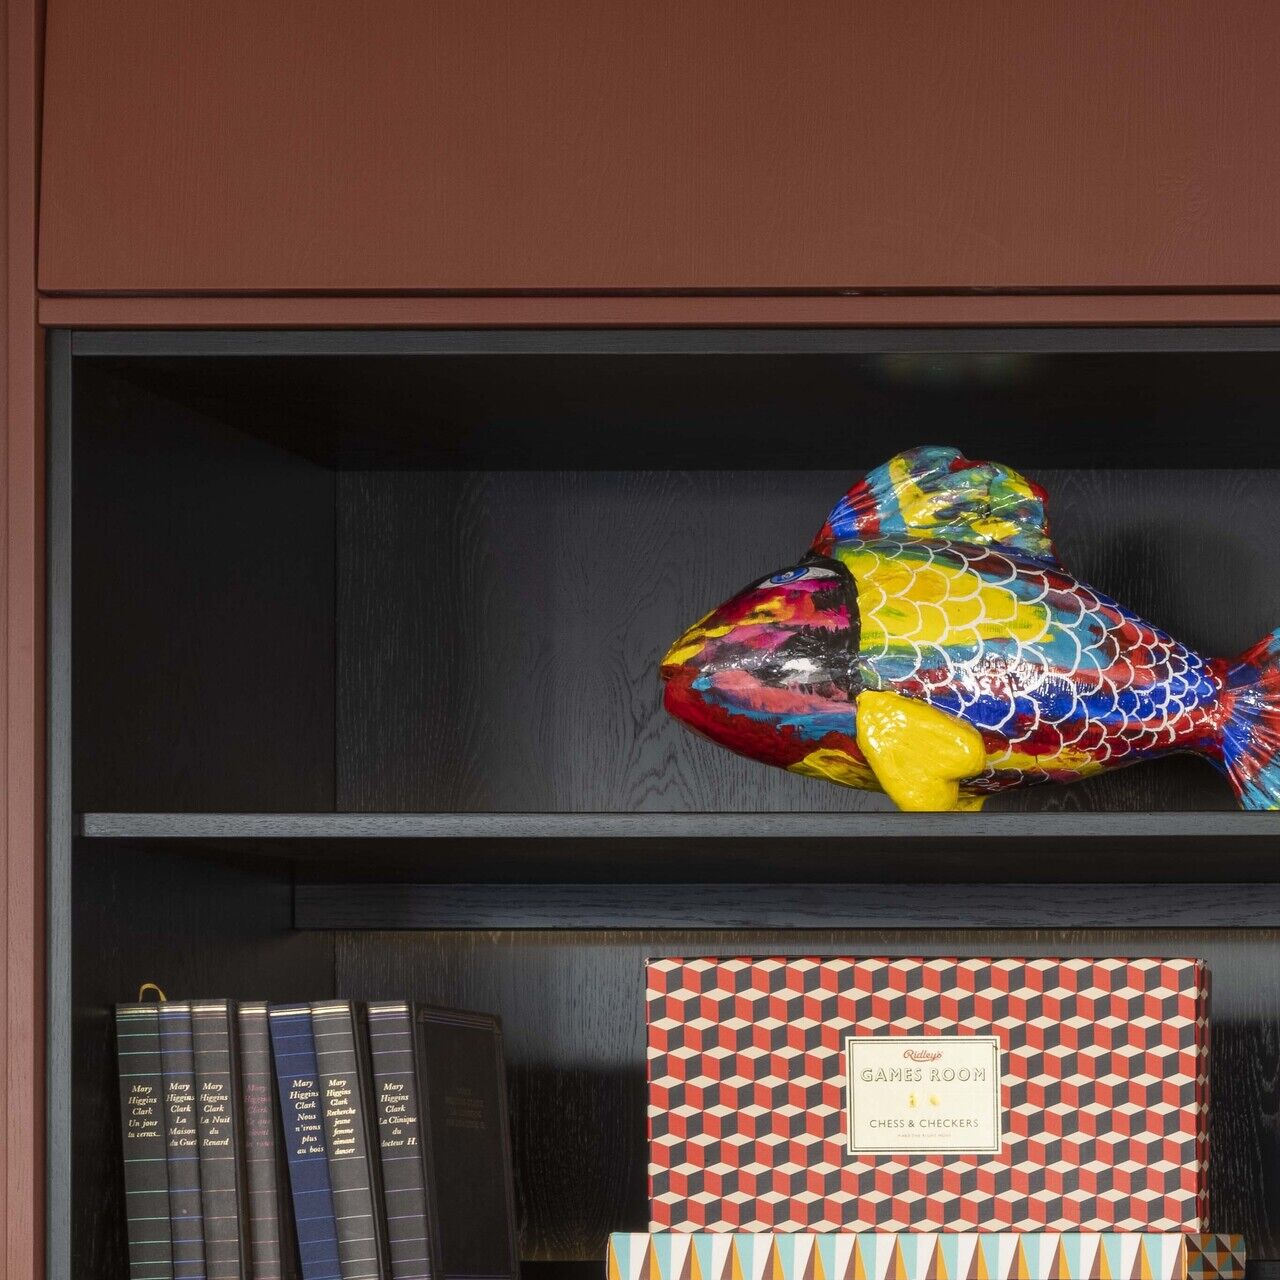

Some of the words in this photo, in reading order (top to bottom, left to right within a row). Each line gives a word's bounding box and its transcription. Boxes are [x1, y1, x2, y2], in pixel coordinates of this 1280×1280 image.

[860, 1067, 922, 1082] GAMES
[930, 1067, 986, 1082] ROOM
[169, 1083, 190, 1092] Mary
[202, 1083, 224, 1092] Mary
[292, 1080, 314, 1088] Mary
[328, 1080, 346, 1088] Mary
[383, 1083, 404, 1092] Mary
[132, 1084, 152, 1094] Mary
[326, 1089, 352, 1097] Higgins
[166, 1094, 196, 1102] Higgins
[200, 1094, 228, 1102] Higgins
[290, 1090, 319, 1100] Higgins
[380, 1094, 409, 1103] Higgins
[128, 1096, 157, 1106] Higgins
[294, 1100, 316, 1110] Clark
[132, 1107, 153, 1115] Clark
[170, 1104, 192, 1112] Clark
[204, 1104, 224, 1112] Clark
[326, 1108, 356, 1116] Recherche
[385, 1104, 406, 1112] Clark
[142, 1118, 158, 1128] jour
[212, 1116, 230, 1124] Nuit
[334, 1118, 351, 1126] jeune
[388, 1116, 417, 1125] Clinique
[869, 1119, 904, 1128] CHESS
[908, 1119, 915, 1128] &
[919, 1118, 980, 1128] CHECKERS
[332, 1128, 354, 1136] femme
[392, 1127, 402, 1135] du
[203, 1138, 230, 1146] Renard
[302, 1136, 318, 1144] plus
[332, 1137, 356, 1146] aimant
[406, 1138, 418, 1146] H.
[310, 1144, 324, 1154] bois
